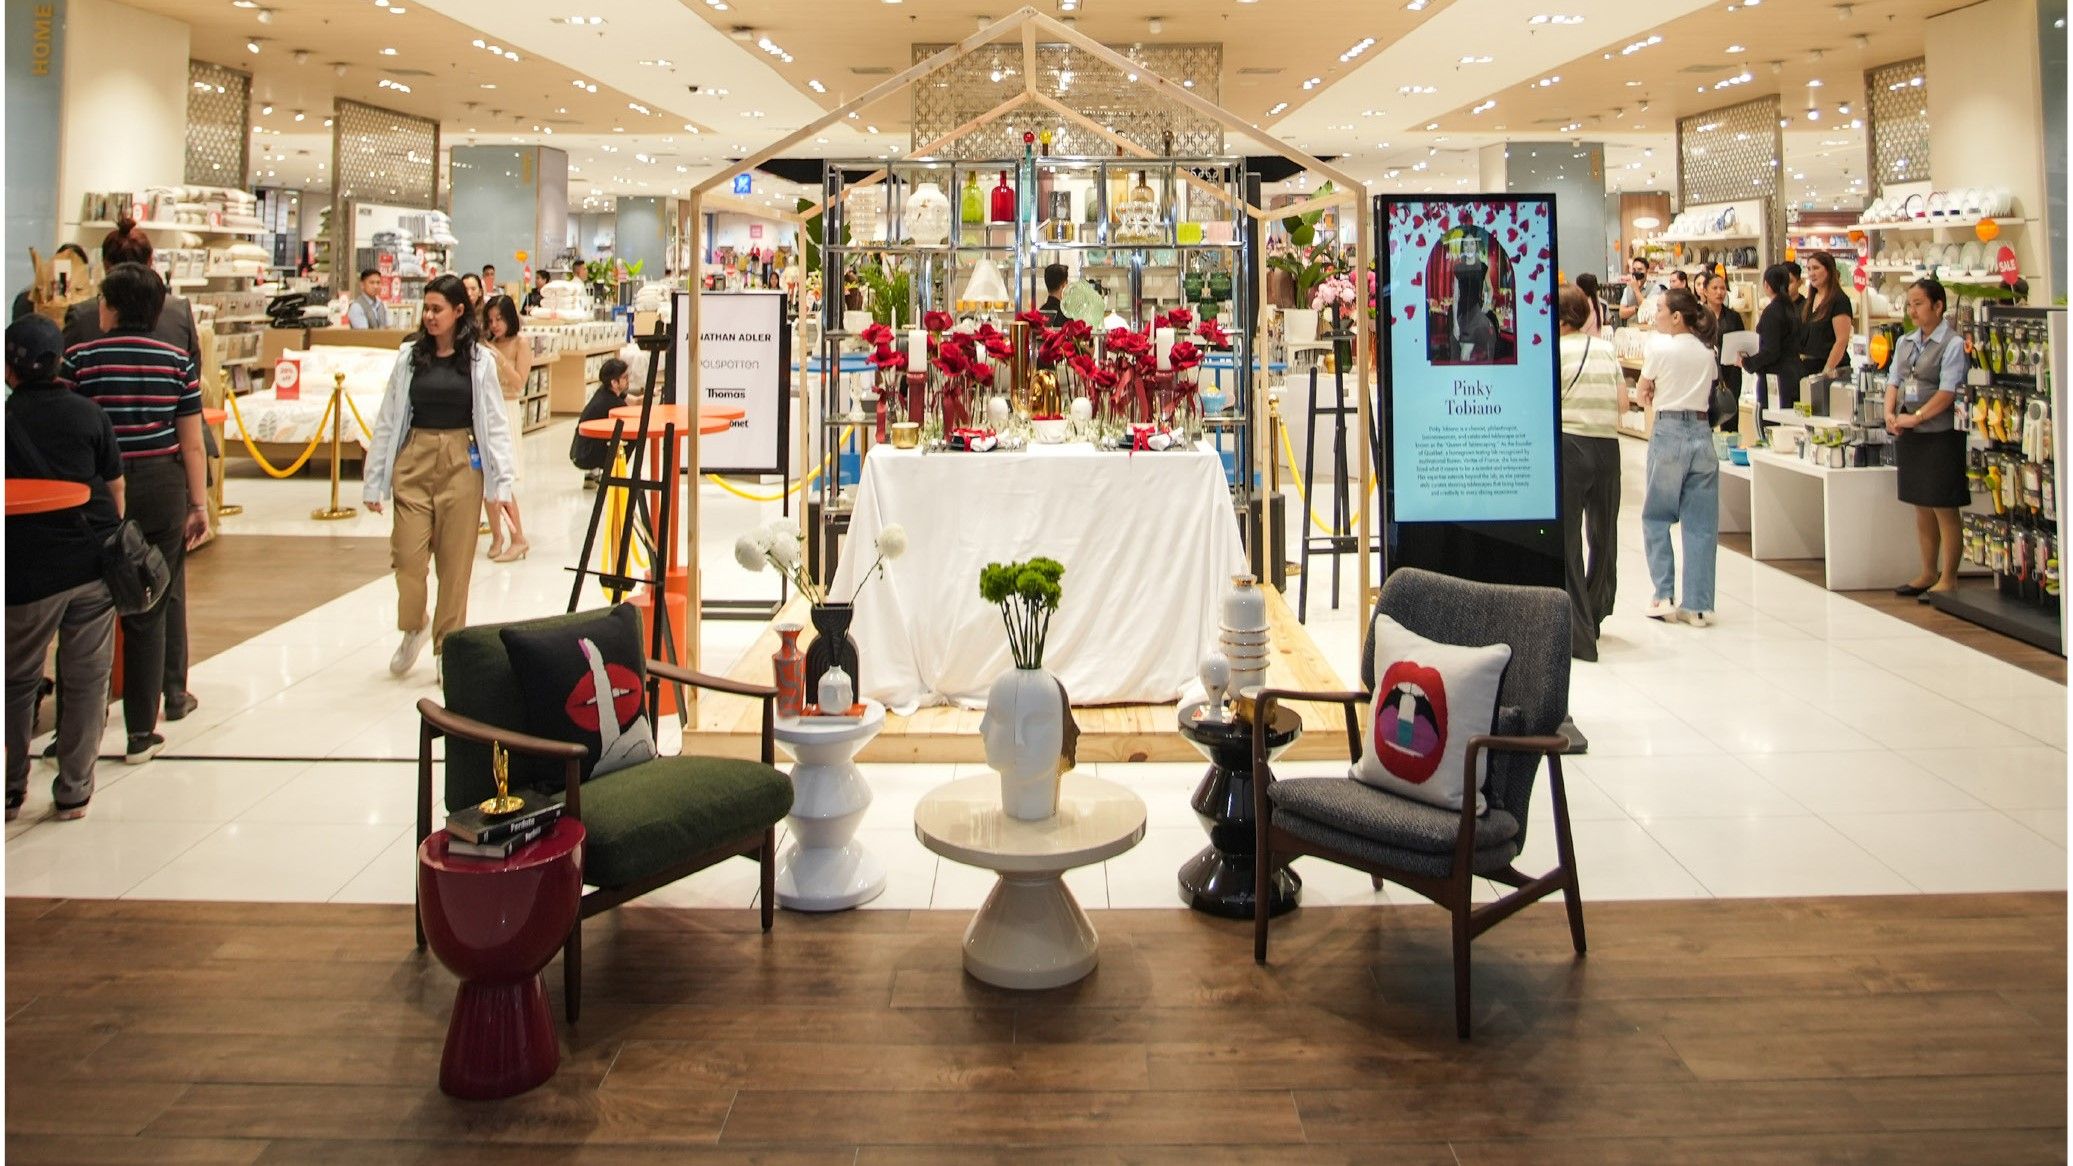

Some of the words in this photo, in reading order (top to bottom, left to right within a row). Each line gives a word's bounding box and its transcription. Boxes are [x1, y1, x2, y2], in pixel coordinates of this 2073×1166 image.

[32, 3, 54, 77] HOME
[1999, 259, 2016, 272] SALE
[685, 333, 735, 341] JATHAN
[739, 333, 771, 341] ADLER
[706, 388, 746, 398] Thomas
[1454, 380, 1491, 400] Pinky
[1445, 399, 1501, 415] Tobiano
[730, 419, 748, 428] onet
